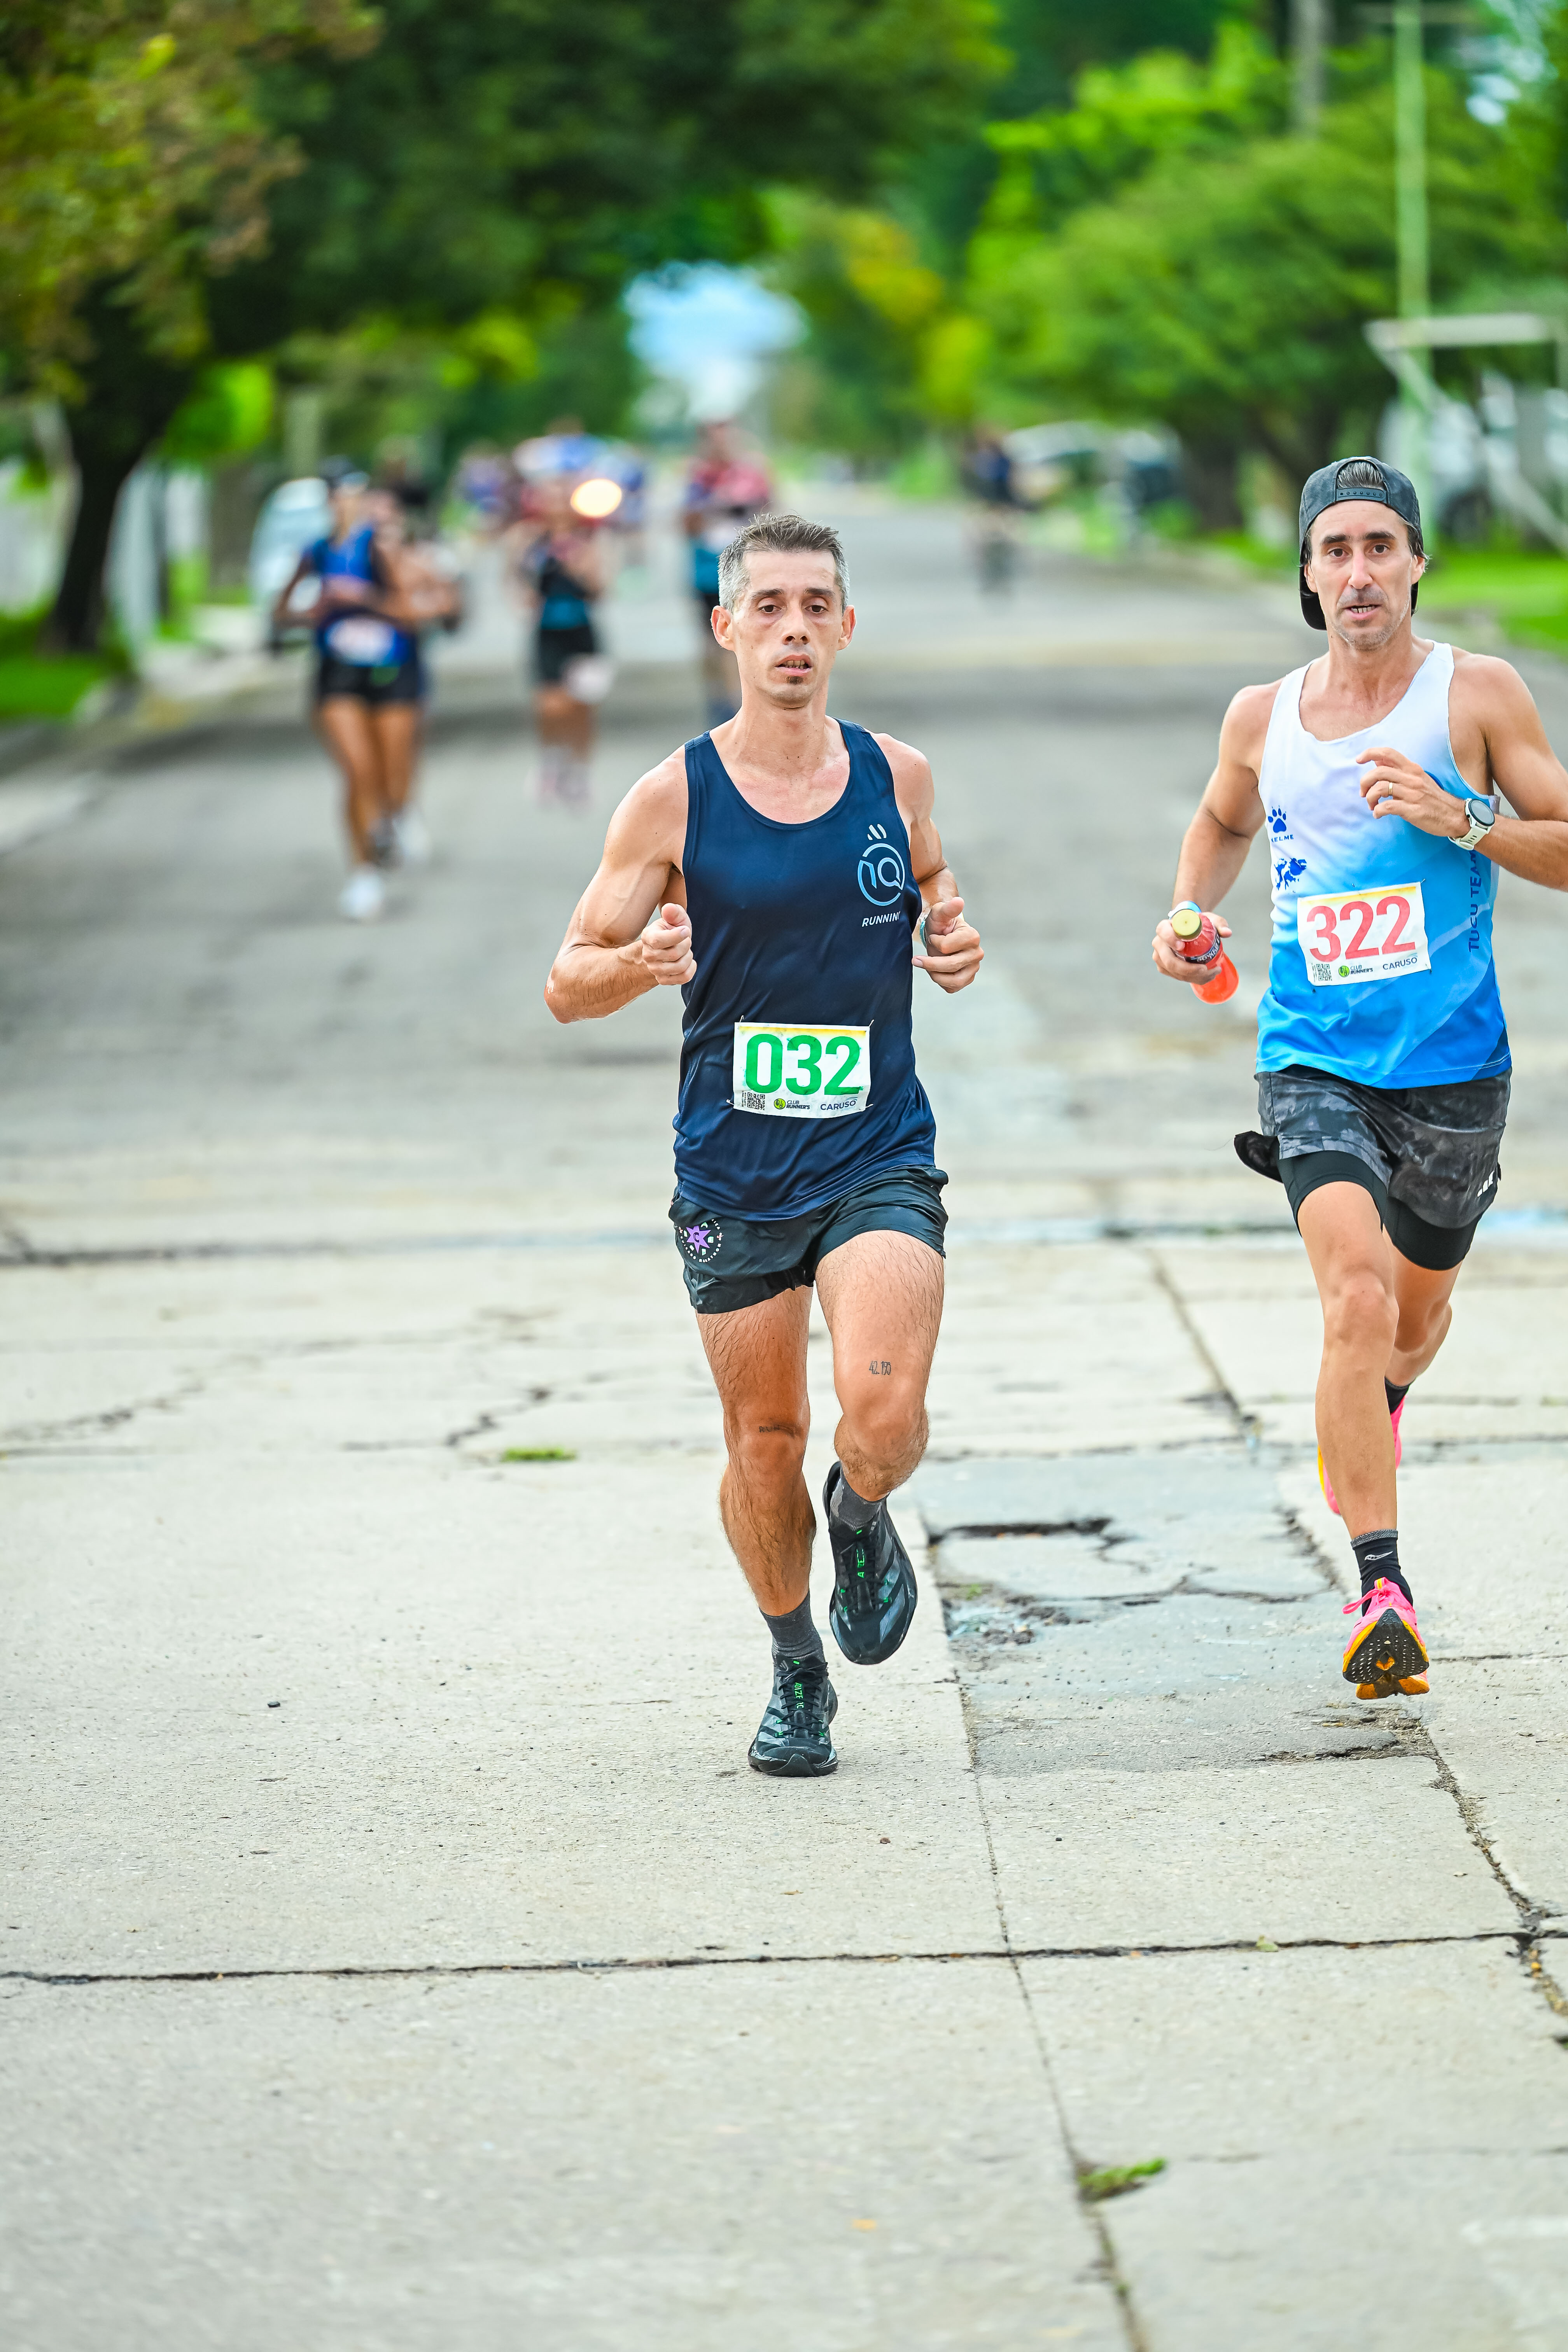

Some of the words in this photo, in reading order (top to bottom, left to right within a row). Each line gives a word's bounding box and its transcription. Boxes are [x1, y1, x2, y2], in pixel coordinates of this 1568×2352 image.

[1307, 896, 1416, 962] 322
[1468, 904, 1480, 952] TUCU
[1382, 957, 1418, 970] CARUSO
[746, 1034, 860, 1096] 032
[820, 1100, 856, 1111] CARUSO
